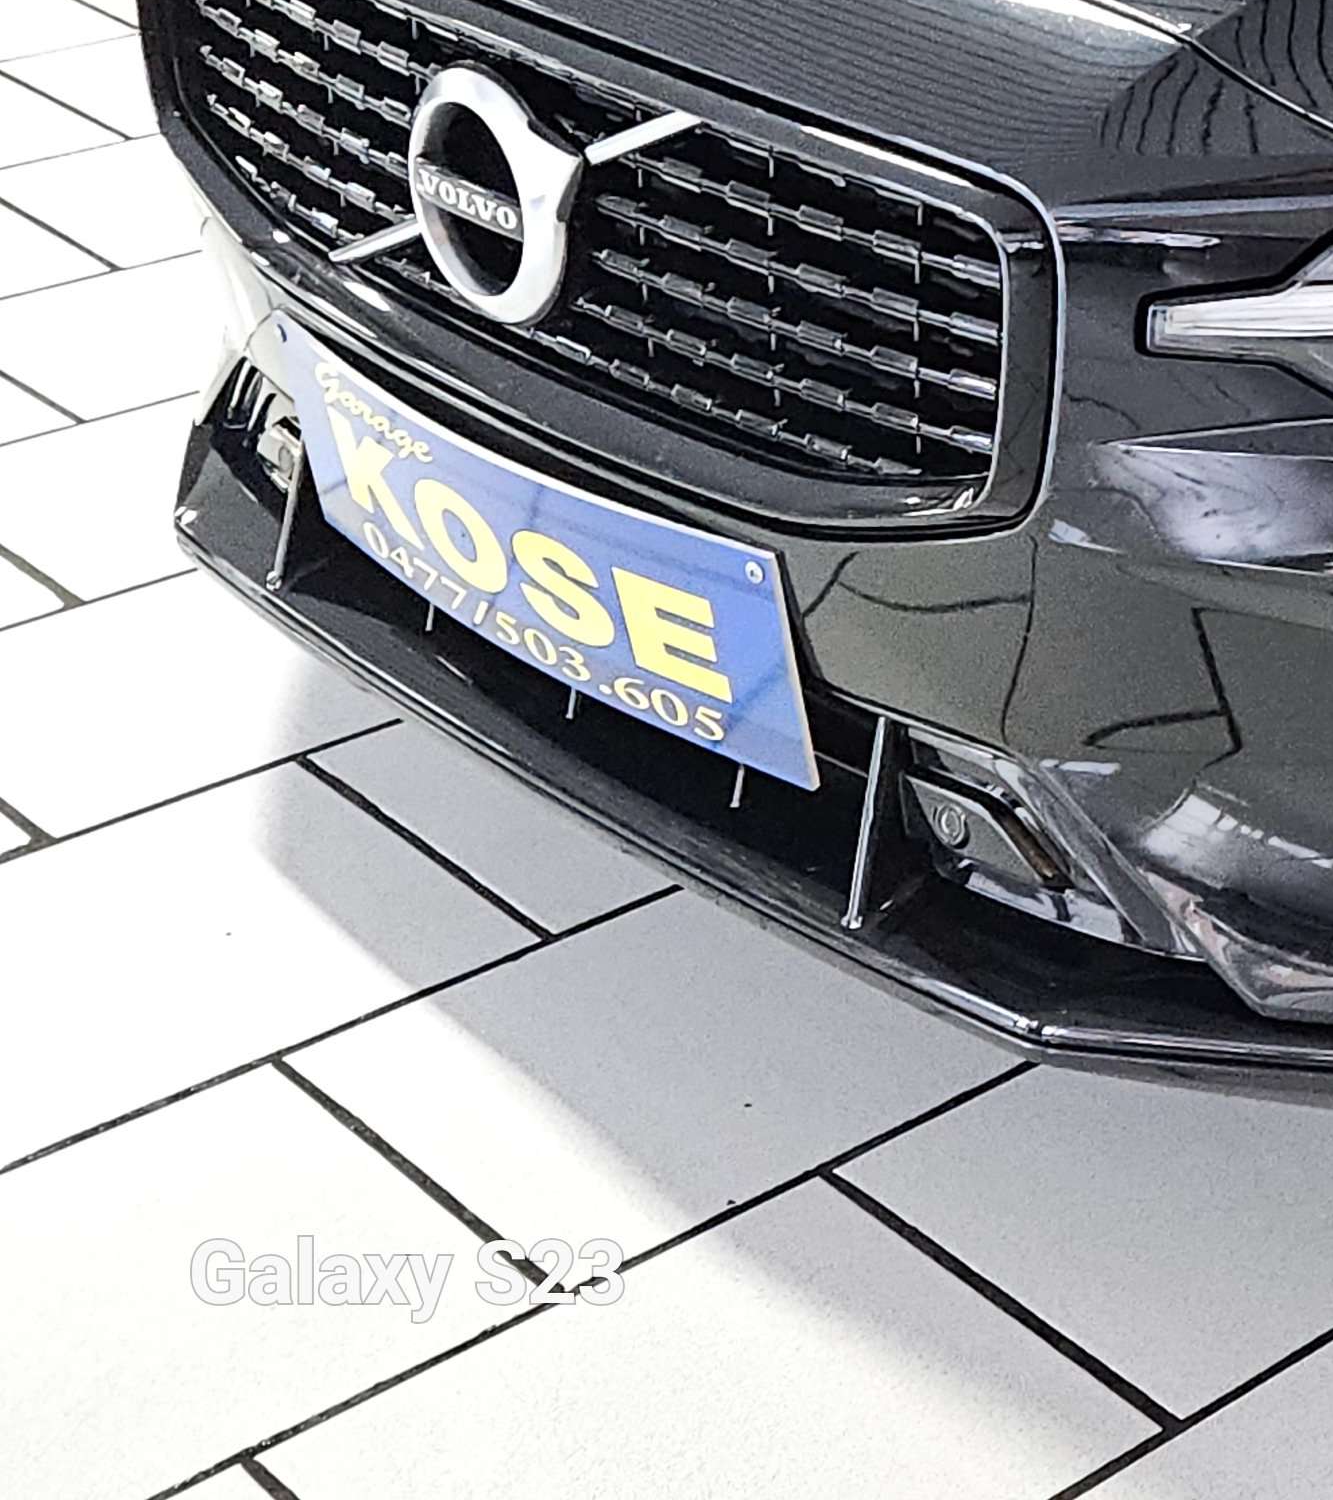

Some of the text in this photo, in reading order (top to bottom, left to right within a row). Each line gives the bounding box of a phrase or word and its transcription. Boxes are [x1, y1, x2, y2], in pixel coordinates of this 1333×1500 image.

[416, 168, 518, 230] VOLVO
[315, 361, 433, 463] Garage
[326, 404, 733, 704] KOSE
[362, 521, 726, 742] 0477/503.605
